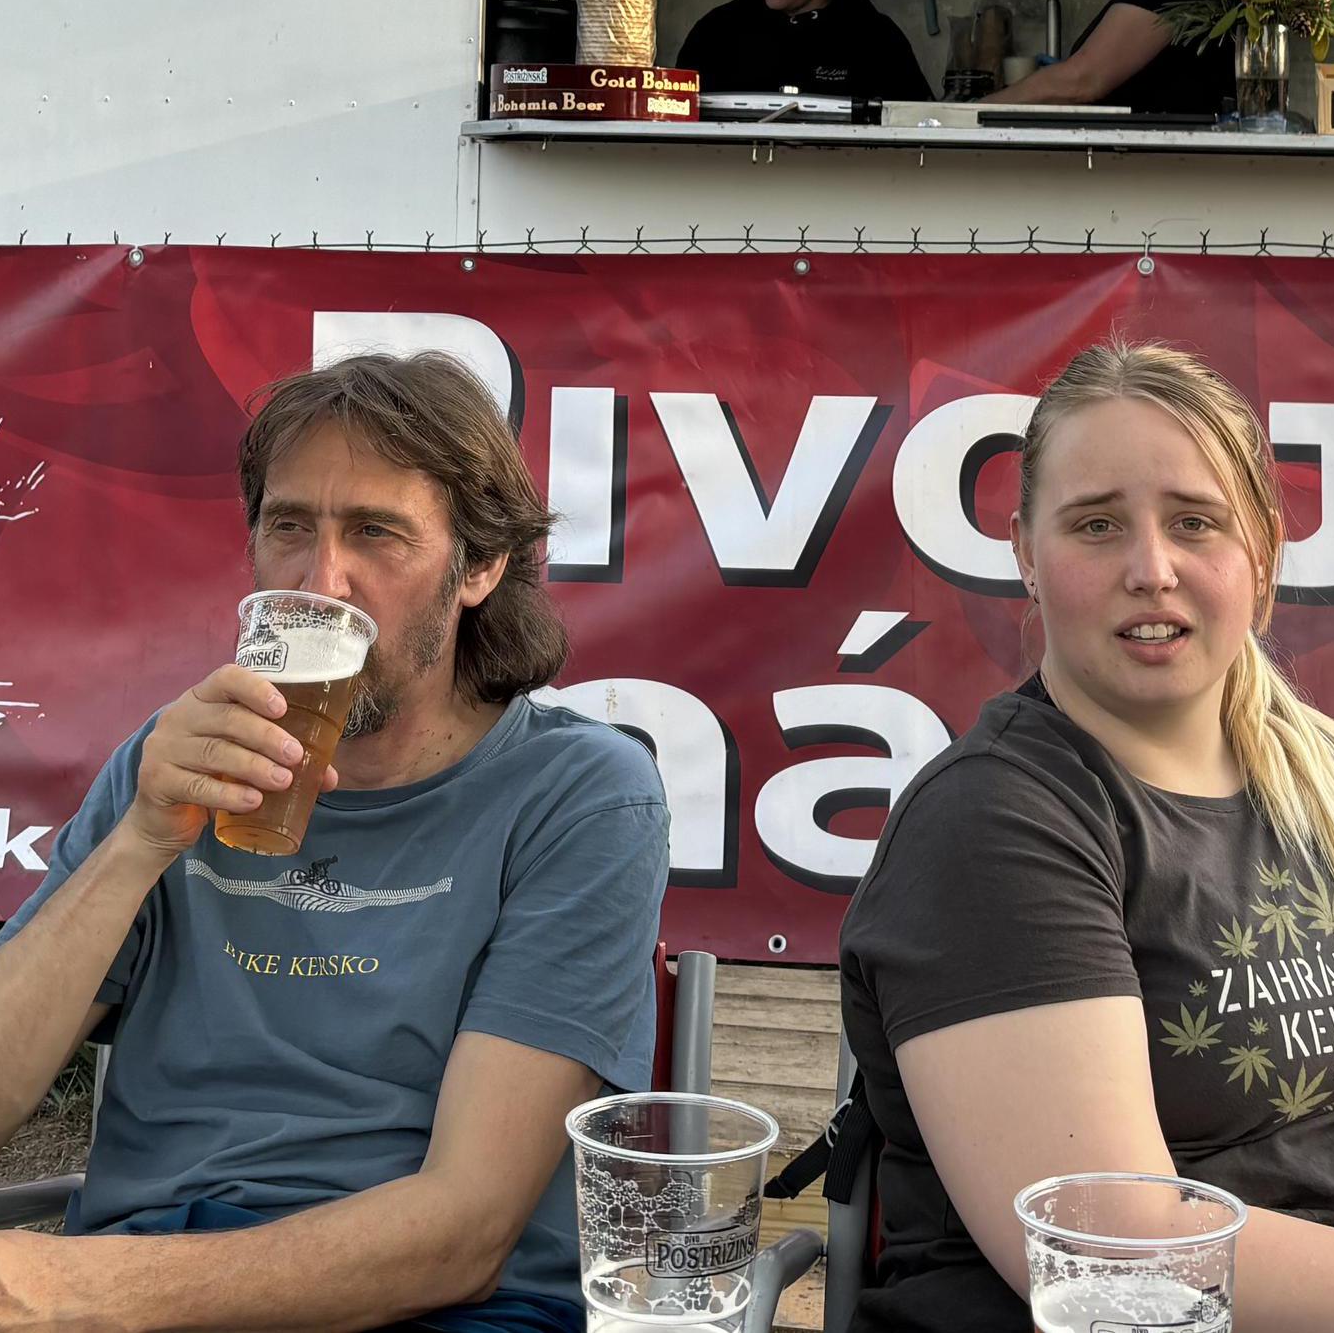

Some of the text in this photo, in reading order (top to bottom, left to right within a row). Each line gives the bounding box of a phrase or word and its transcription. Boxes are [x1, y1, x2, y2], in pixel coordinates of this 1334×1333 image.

[590, 68, 637, 88] Gold
[497, 93, 559, 112] Bohemia
[561, 91, 606, 112] Beer
[288, 955, 380, 977] KERSKO
